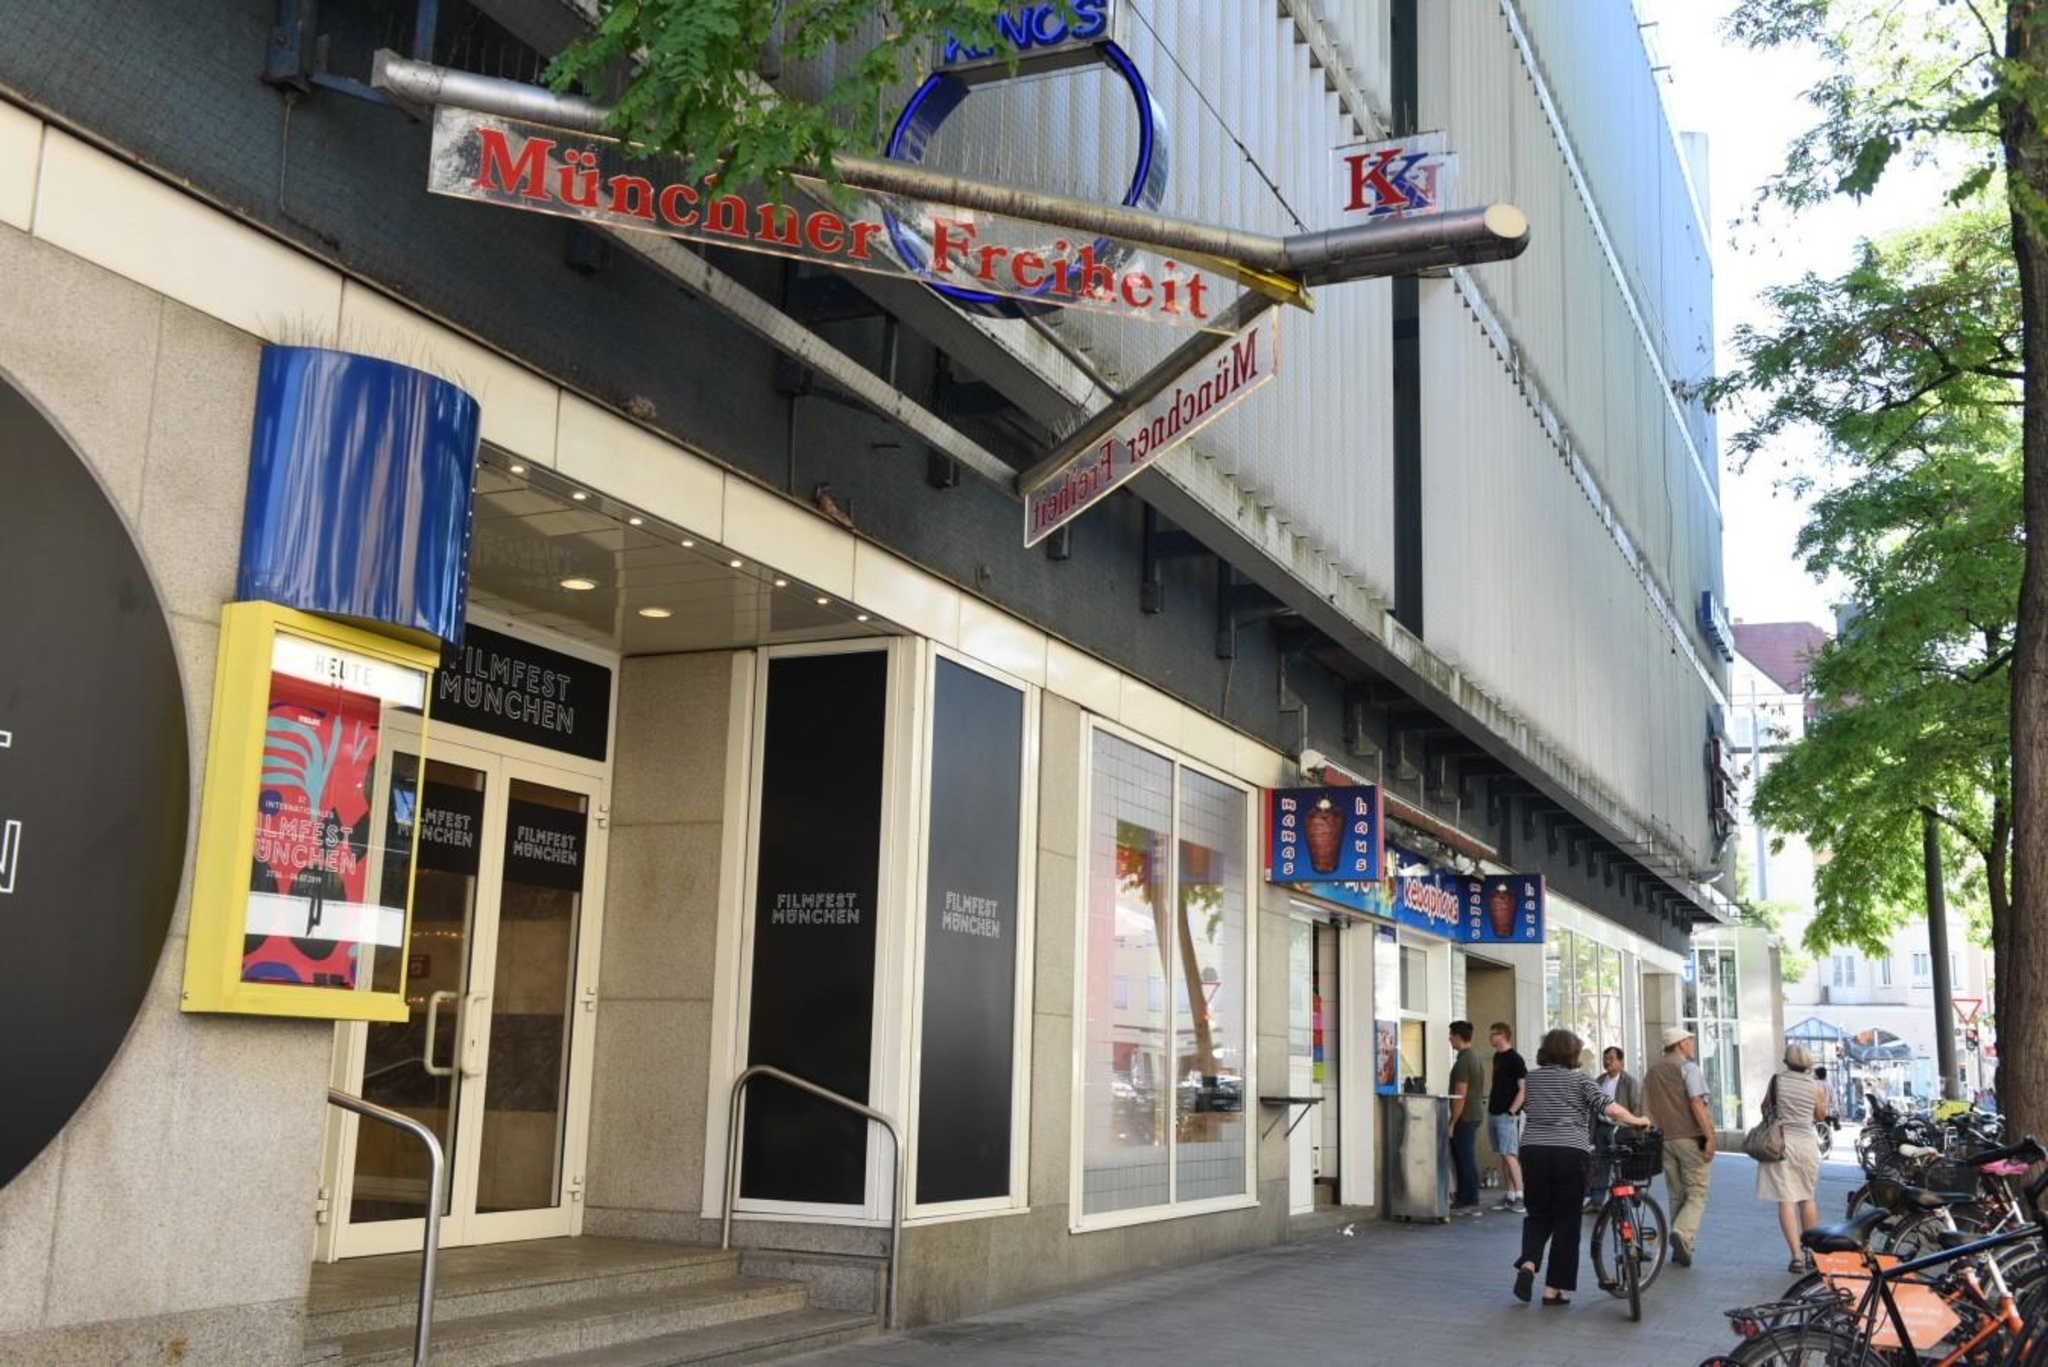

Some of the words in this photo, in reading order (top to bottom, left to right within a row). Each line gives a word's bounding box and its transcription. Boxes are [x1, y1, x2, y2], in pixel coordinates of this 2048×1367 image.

[944, 0, 1107, 64] KNOS
[474, 126, 882, 260] Münchner
[932, 216, 1209, 319] Freiheit
[448, 645, 571, 702] ILMFEST
[440, 671, 575, 734] MÜNCHEN
[254, 813, 353, 849] ILMFEST
[397, 822, 474, 849] MNCHEN
[517, 825, 577, 850] FILMFEST
[1281, 797, 1297, 876] mamas
[1354, 796, 1369, 872] haus
[254, 838, 357, 876] ÜNCHEN
[513, 841, 578, 867] MÜNCHEN
[772, 908, 860, 925] MÜNCHEN
[777, 893, 857, 909] FILMFEST
[945, 891, 998, 919] FILMFEST
[941, 912, 1001, 939] MÜNCHEN
